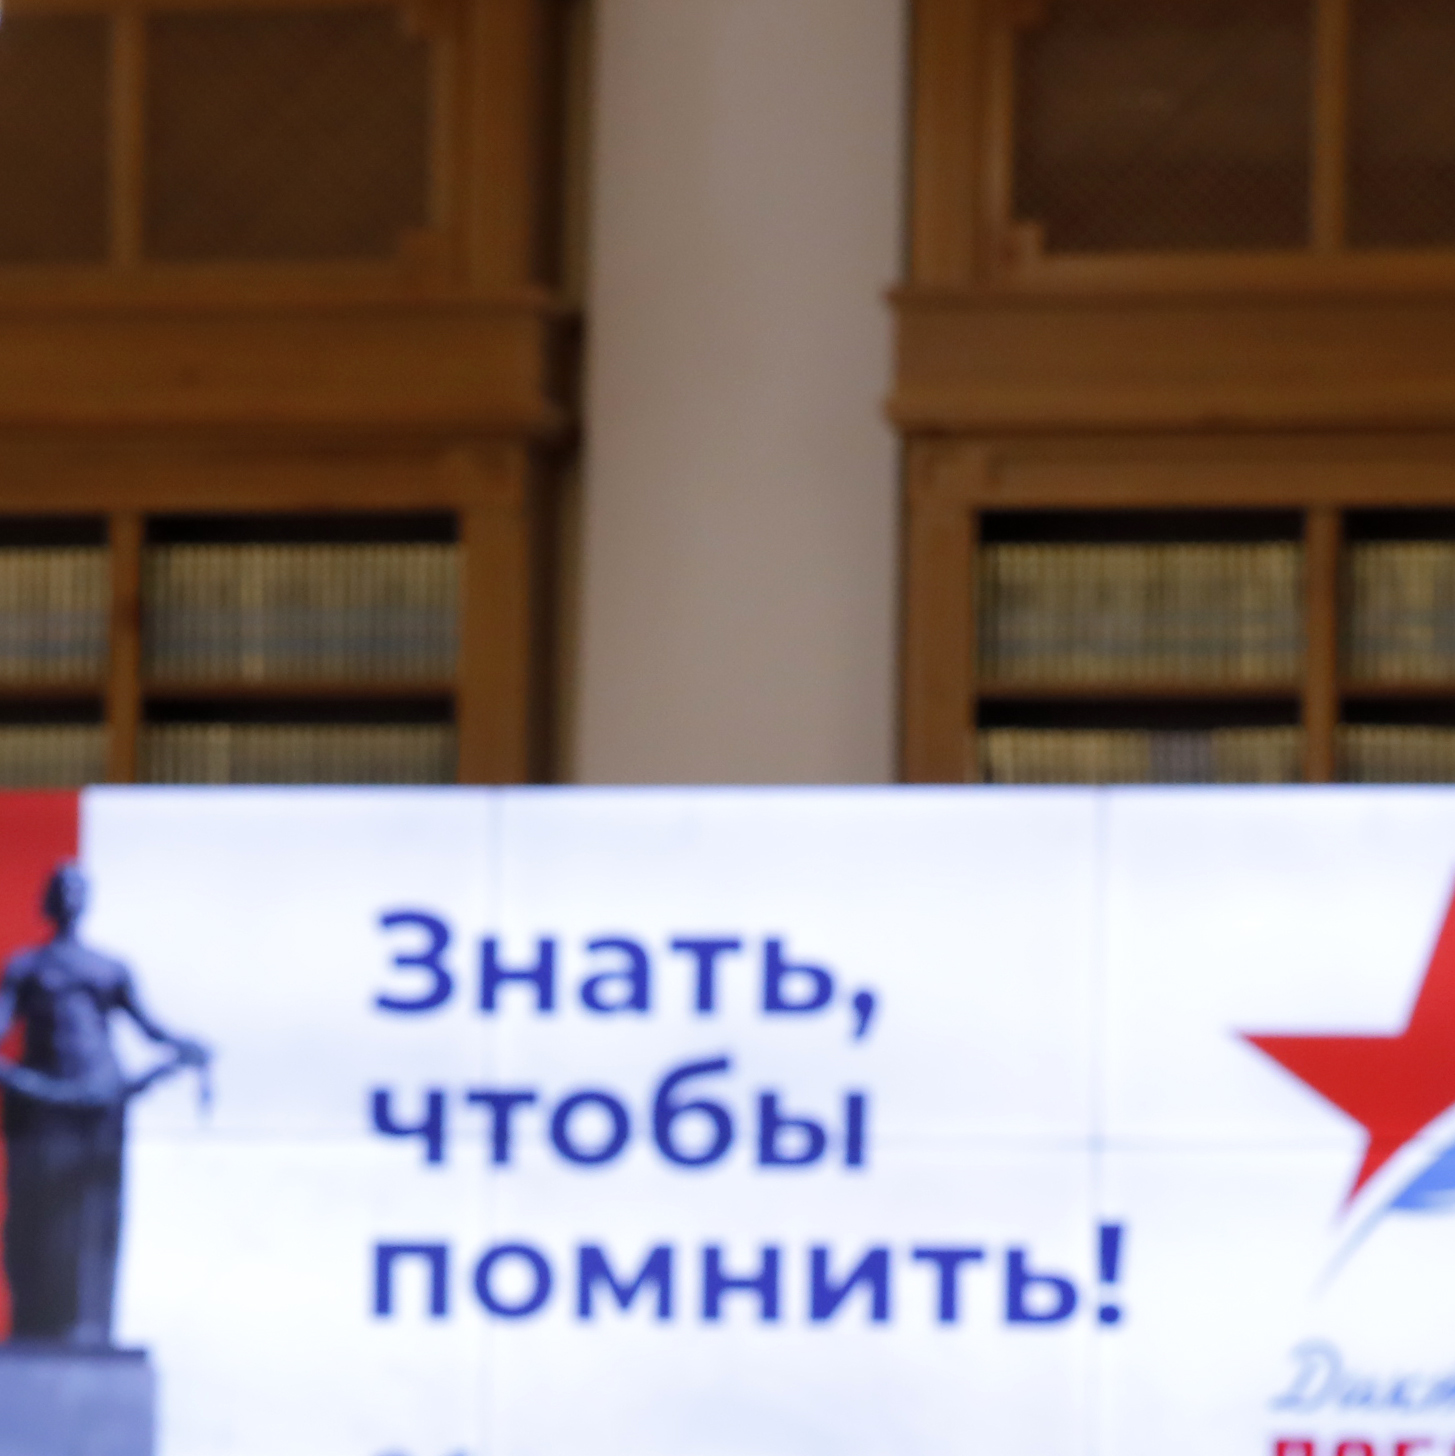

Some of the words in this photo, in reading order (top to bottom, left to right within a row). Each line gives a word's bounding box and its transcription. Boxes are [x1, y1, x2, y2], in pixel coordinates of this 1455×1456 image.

[374, 908, 879, 1041] Знать,
[371, 1052, 866, 1168] чтобы
[372, 1223, 1125, 1327] помнить!
